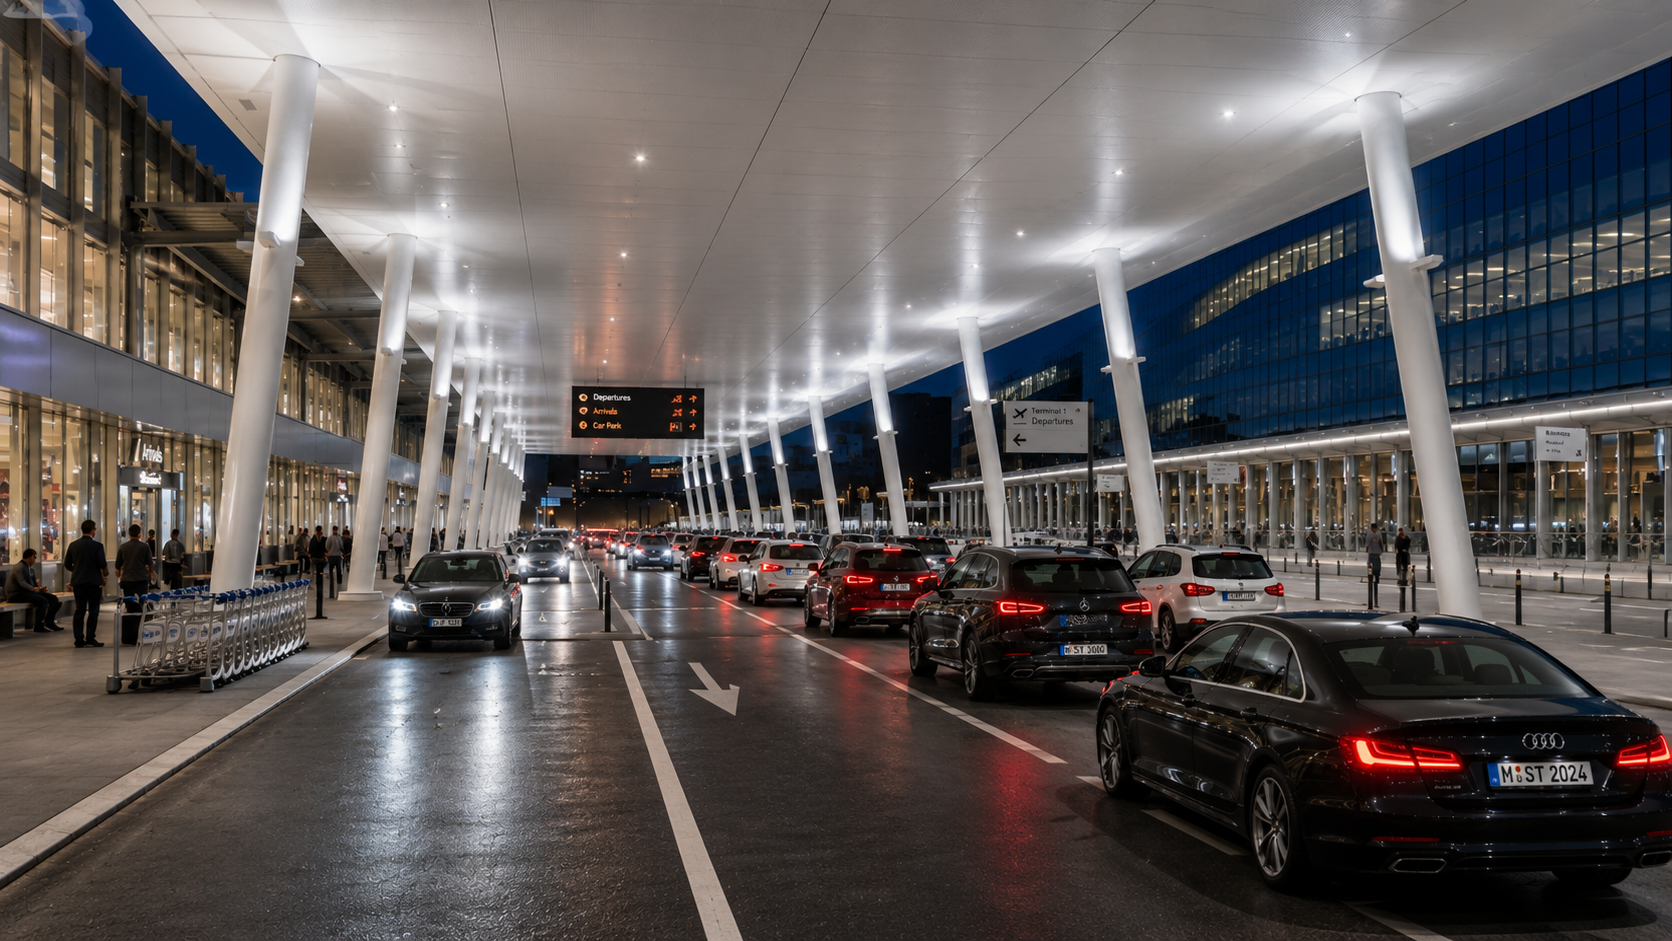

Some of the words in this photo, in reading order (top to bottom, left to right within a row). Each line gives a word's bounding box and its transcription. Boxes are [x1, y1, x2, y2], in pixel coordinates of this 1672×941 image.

[593, 393, 631, 402] Departures
[593, 407, 618, 415] Arrivals
[1031, 407, 1061, 415] Terminal
[593, 422, 605, 430] Car
[606, 422, 622, 430] Park
[1031, 417, 1074, 427] Departures
[1501, 765, 1514, 783] M
[1524, 765, 1544, 783] ST
[1549, 764, 1588, 783] 2024
